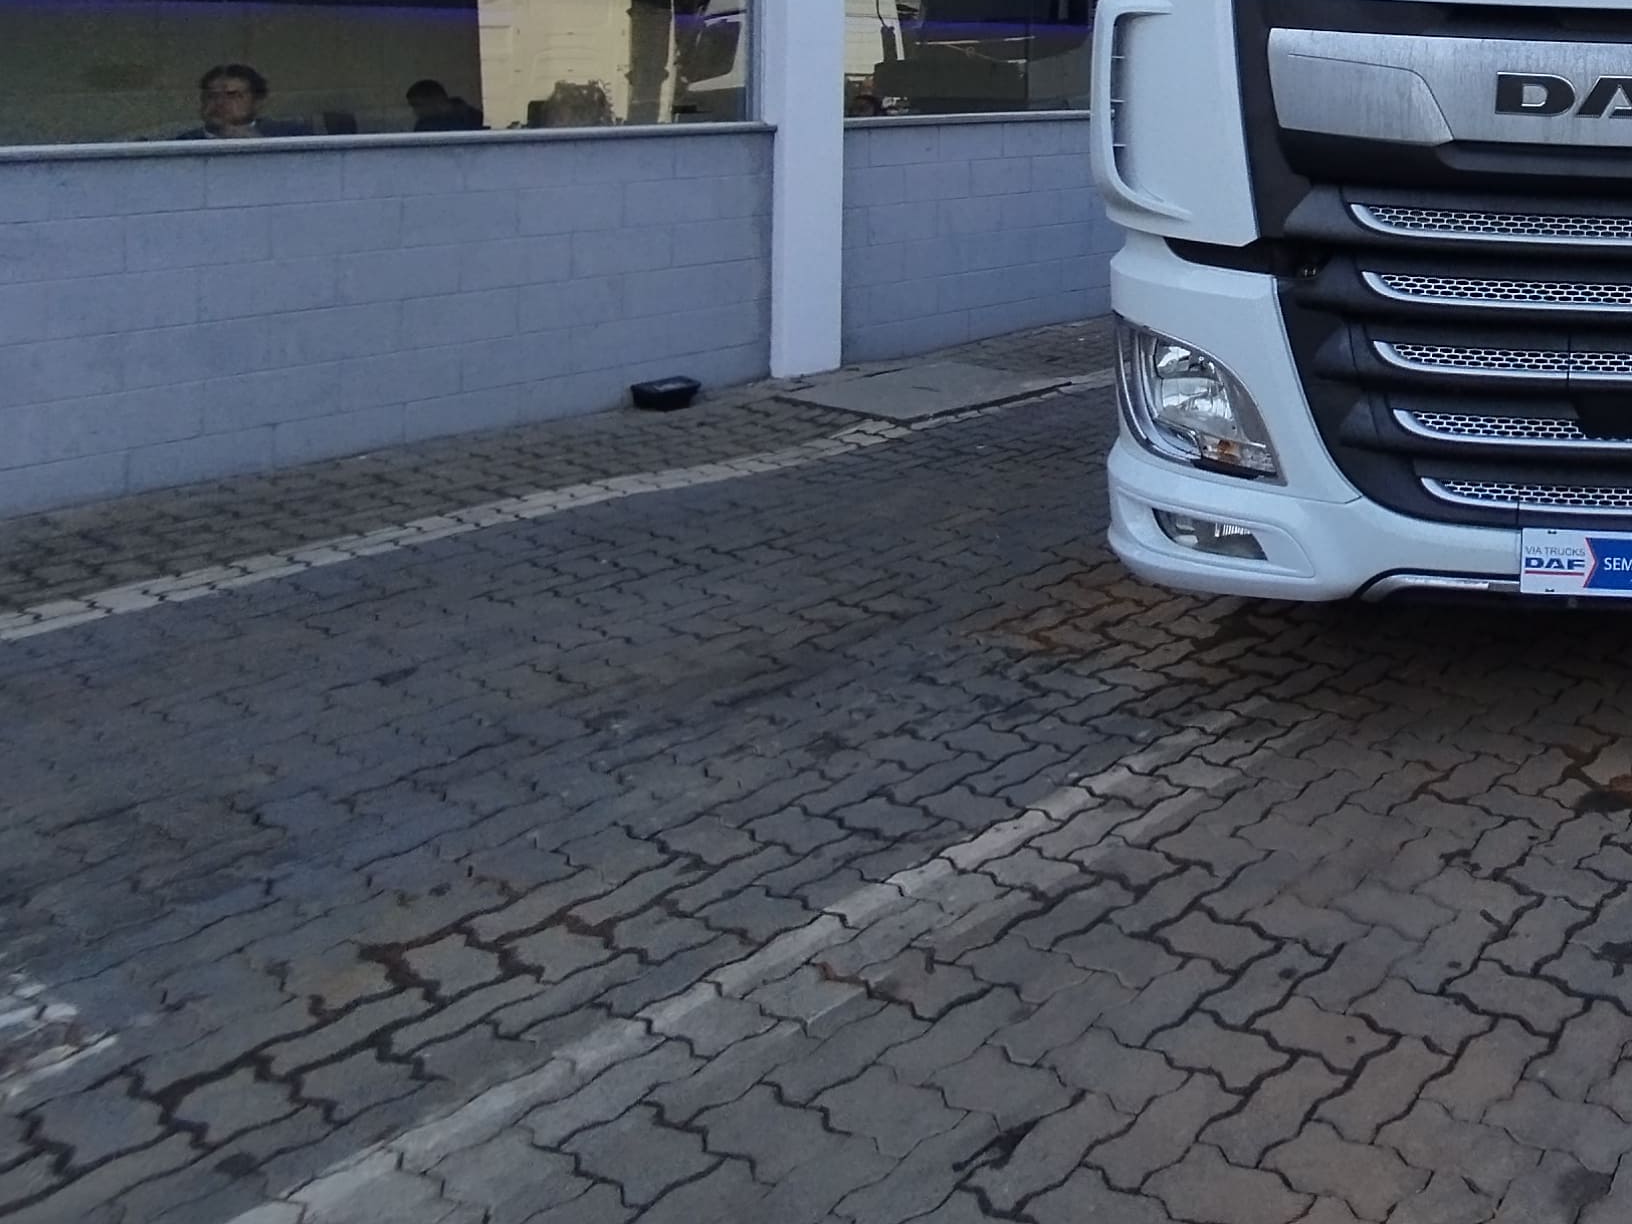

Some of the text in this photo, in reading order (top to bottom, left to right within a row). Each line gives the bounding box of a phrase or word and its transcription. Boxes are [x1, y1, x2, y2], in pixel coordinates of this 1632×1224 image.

[1525, 546, 1585, 556] VIA TRUCKS
[1525, 557, 1585, 570] DAF
